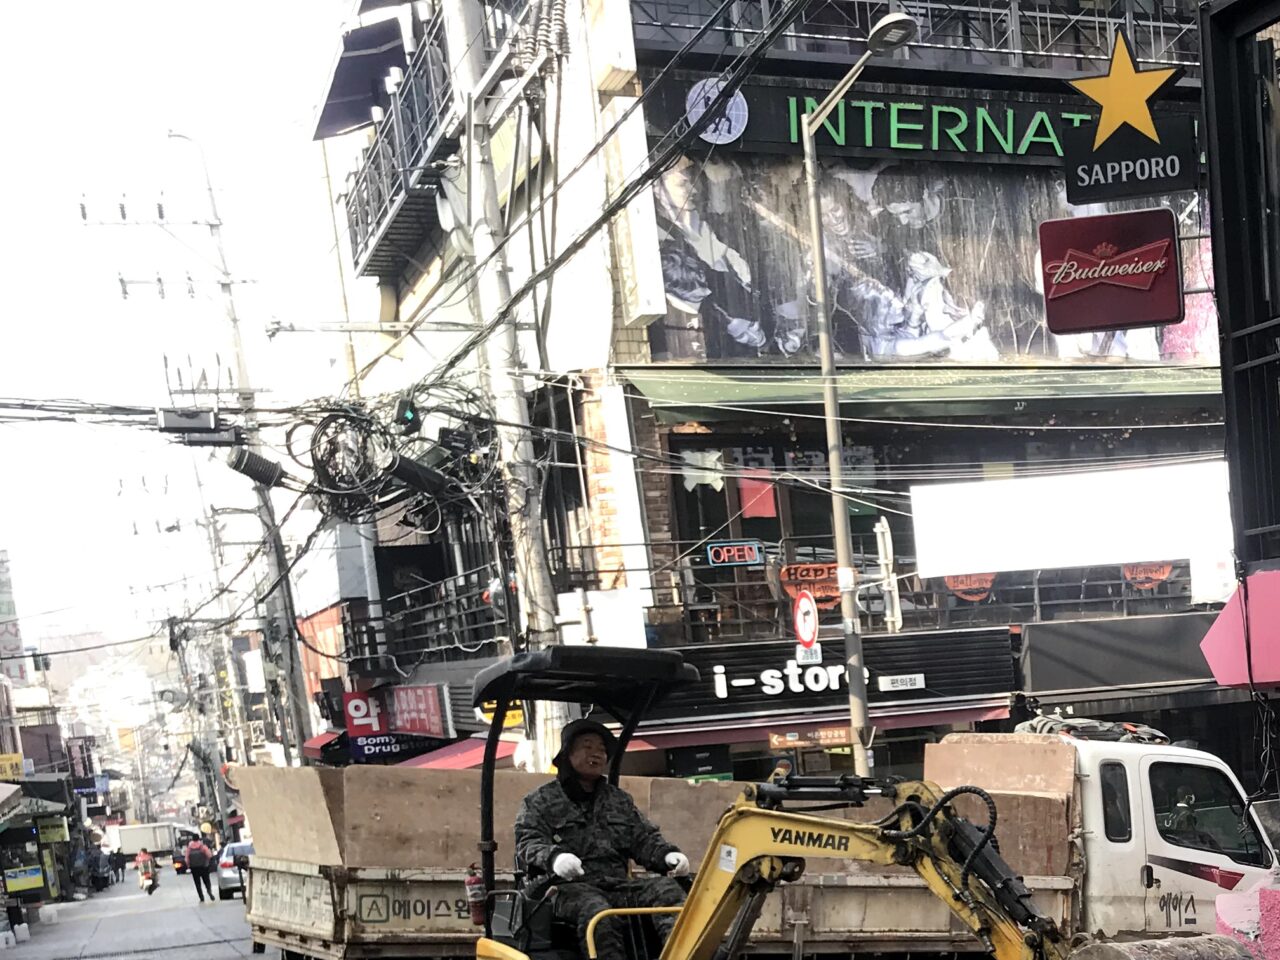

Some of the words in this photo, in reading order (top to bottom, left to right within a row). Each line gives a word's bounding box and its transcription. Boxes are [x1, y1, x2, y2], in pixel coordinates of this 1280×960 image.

[788, 96, 1092, 157] INTERNAT
[1077, 155, 1180, 187] SAPPORO
[1046, 257, 1168, 284] Budweiser
[711, 545, 756, 563] OPEN
[890, 677, 917, 688] 편의점
[347, 698, 381, 732] 약
[771, 827, 850, 851] YANMAR
[1159, 891, 1197, 928] 에이스
